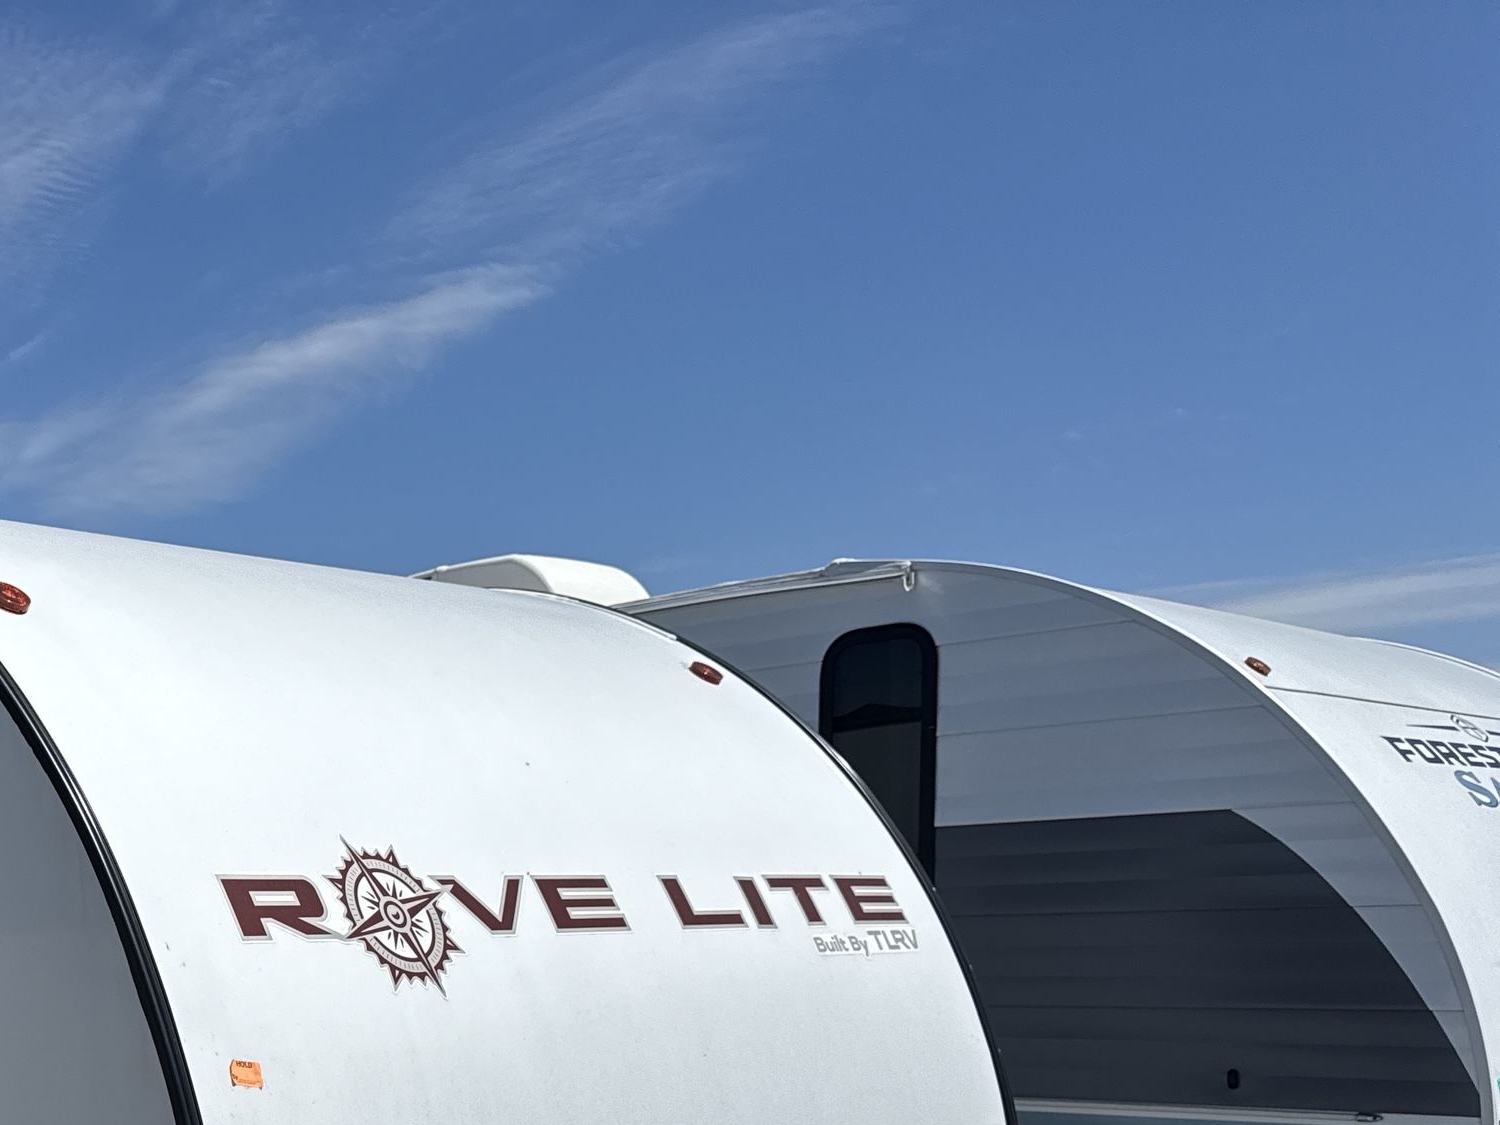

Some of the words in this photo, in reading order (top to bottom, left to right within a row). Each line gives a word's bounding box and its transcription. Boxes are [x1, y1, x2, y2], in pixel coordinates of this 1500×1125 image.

[1380, 735, 1500, 768] FORES
[1454, 770, 1500, 808] S
[214, 843, 632, 985] ROVE
[656, 875, 910, 930] LITE
[813, 935, 849, 953] Built
[849, 935, 870, 956] By
[867, 929, 919, 951] TLRV
